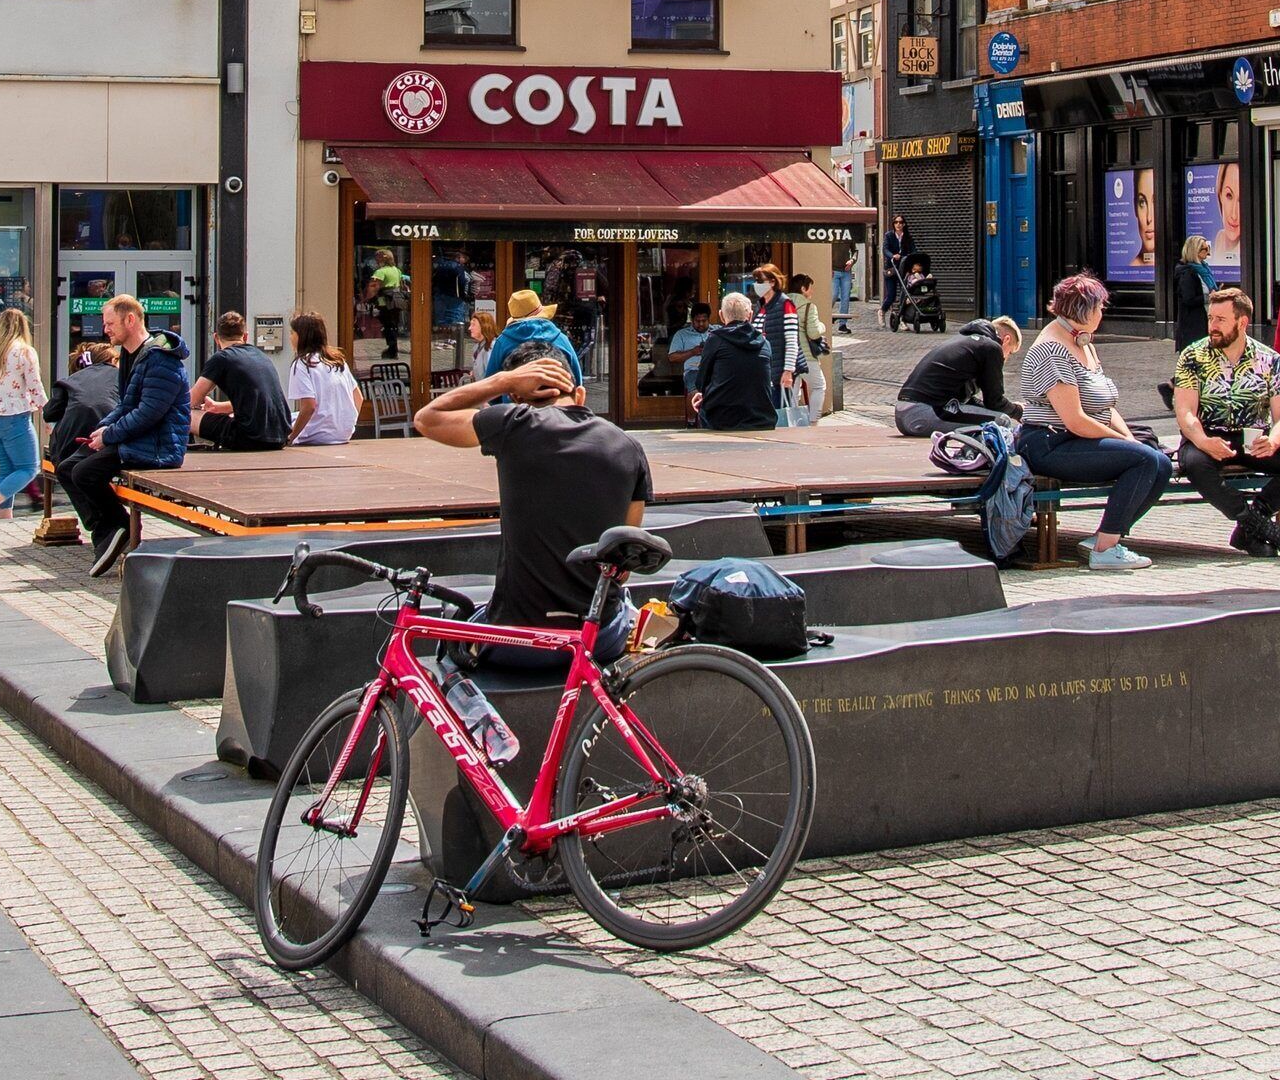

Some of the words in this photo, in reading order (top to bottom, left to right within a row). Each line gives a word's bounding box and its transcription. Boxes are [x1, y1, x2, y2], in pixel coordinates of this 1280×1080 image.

[911, 38, 926, 47] THE
[992, 42, 1017, 51] Dolphin
[902, 47, 934, 59] LOCK
[902, 60, 934, 72] SHOP
[396, 74, 435, 91] COSTA
[470, 73, 683, 134] COSTA
[996, 101, 1025, 118] DENTIST
[392, 109, 440, 130] COFFEE
[881, 142, 898, 160] THE
[901, 139, 924, 158] LOCK
[927, 136, 951, 155] SHOP
[391, 224, 439, 237] COSTA
[574, 228, 595, 239] FOR
[597, 228, 636, 240] COFFEE
[638, 229, 678, 240] LOVERS
[807, 228, 852, 241] COSTA
[813, 698, 832, 713] THE
[838, 695, 877, 713] REALLY
[943, 687, 980, 705] THINGS
[987, 687, 1003, 702] WE
[1005, 685, 1019, 701] DO
[1025, 684, 1036, 699] IN
[1039, 682, 1058, 697] OR
[1061, 679, 1086, 696] LIVES
[1121, 677, 1132, 691] US
[1135, 675, 1149, 690] TO
